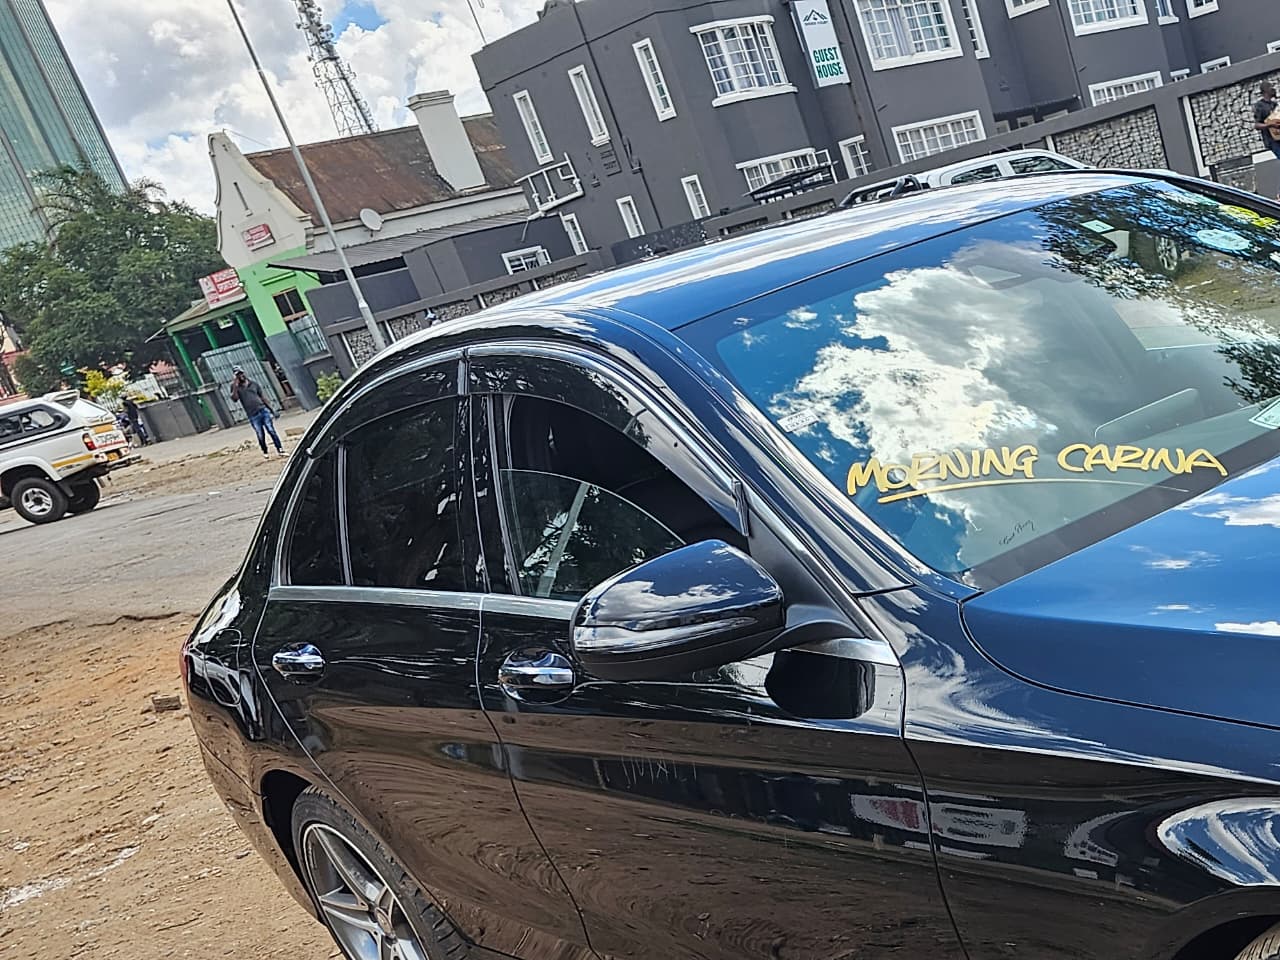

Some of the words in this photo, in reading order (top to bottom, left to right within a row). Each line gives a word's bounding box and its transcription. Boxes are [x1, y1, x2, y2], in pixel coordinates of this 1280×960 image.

[813, 47, 839, 63] GUEST
[816, 62, 844, 78] HOUSE
[847, 445, 1038, 496] MORNING
[1057, 443, 1228, 477] CARINA
